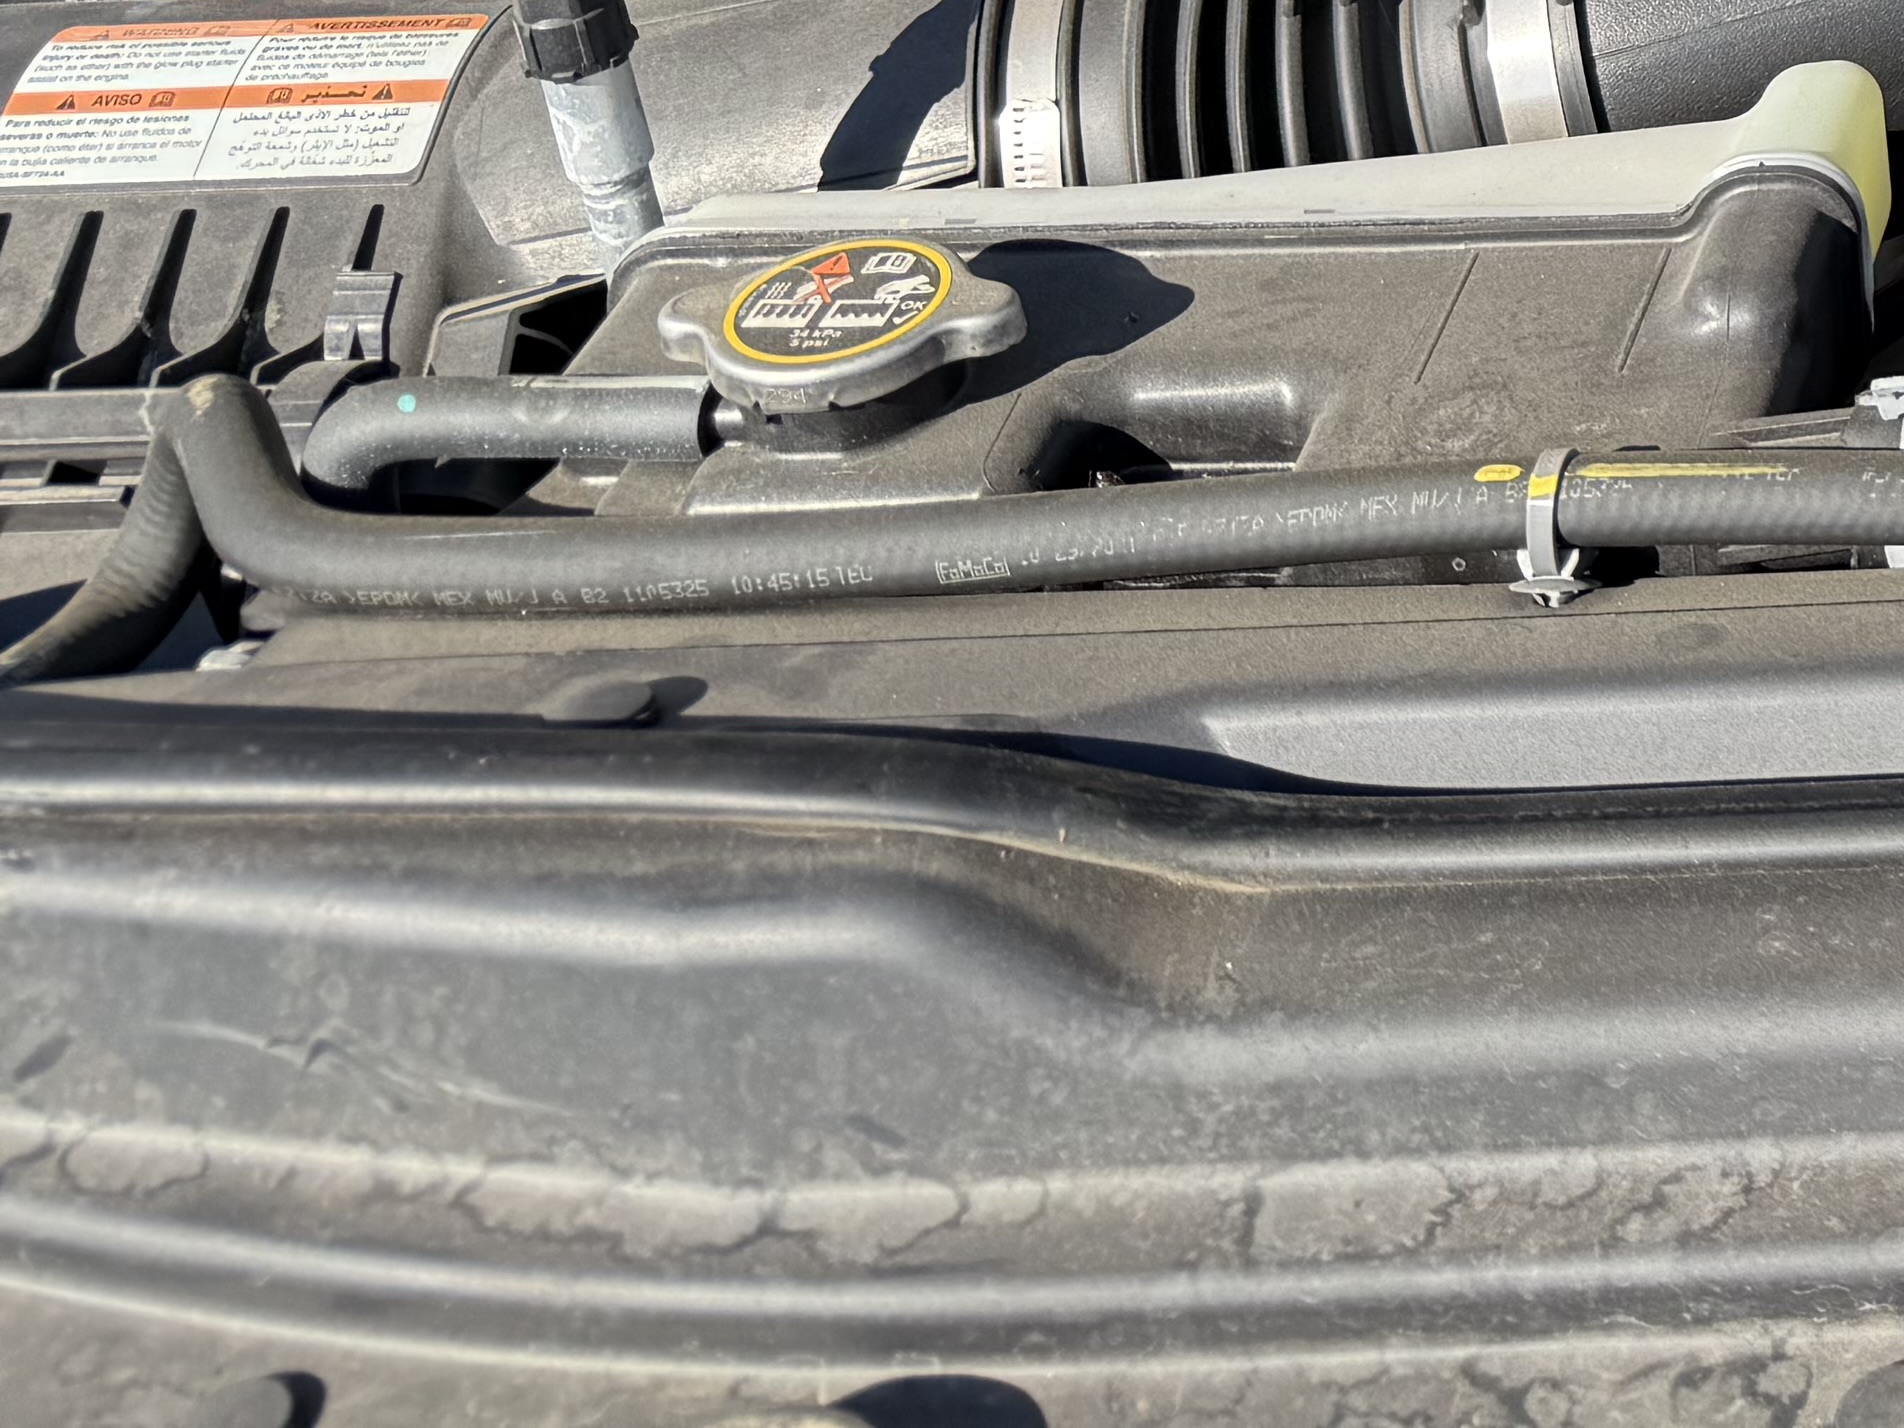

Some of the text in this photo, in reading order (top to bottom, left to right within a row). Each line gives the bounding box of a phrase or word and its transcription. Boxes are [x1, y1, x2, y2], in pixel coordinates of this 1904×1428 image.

[308, 17, 447, 32] AVERTISSEMENT
[136, 60, 153, 70] the
[75, 74, 92, 82] the
[91, 93, 144, 108] AVISO
[5, 114, 191, 128] Para reducir el riesgo de lesiones
[101, 129, 117, 138] No
[119, 129, 139, 138] use
[177, 126, 192, 136] de
[159, 139, 171, 149] el
[171, 138, 204, 149] motor
[93, 153, 108, 165] de
[900, 299, 929, 311] OK
[789, 328, 843, 339] 34 kPa
[789, 338, 830, 350] 5 psi
[936, 559, 1010, 584] FoMoCo
[730, 565, 831, 596] 10:45:15
